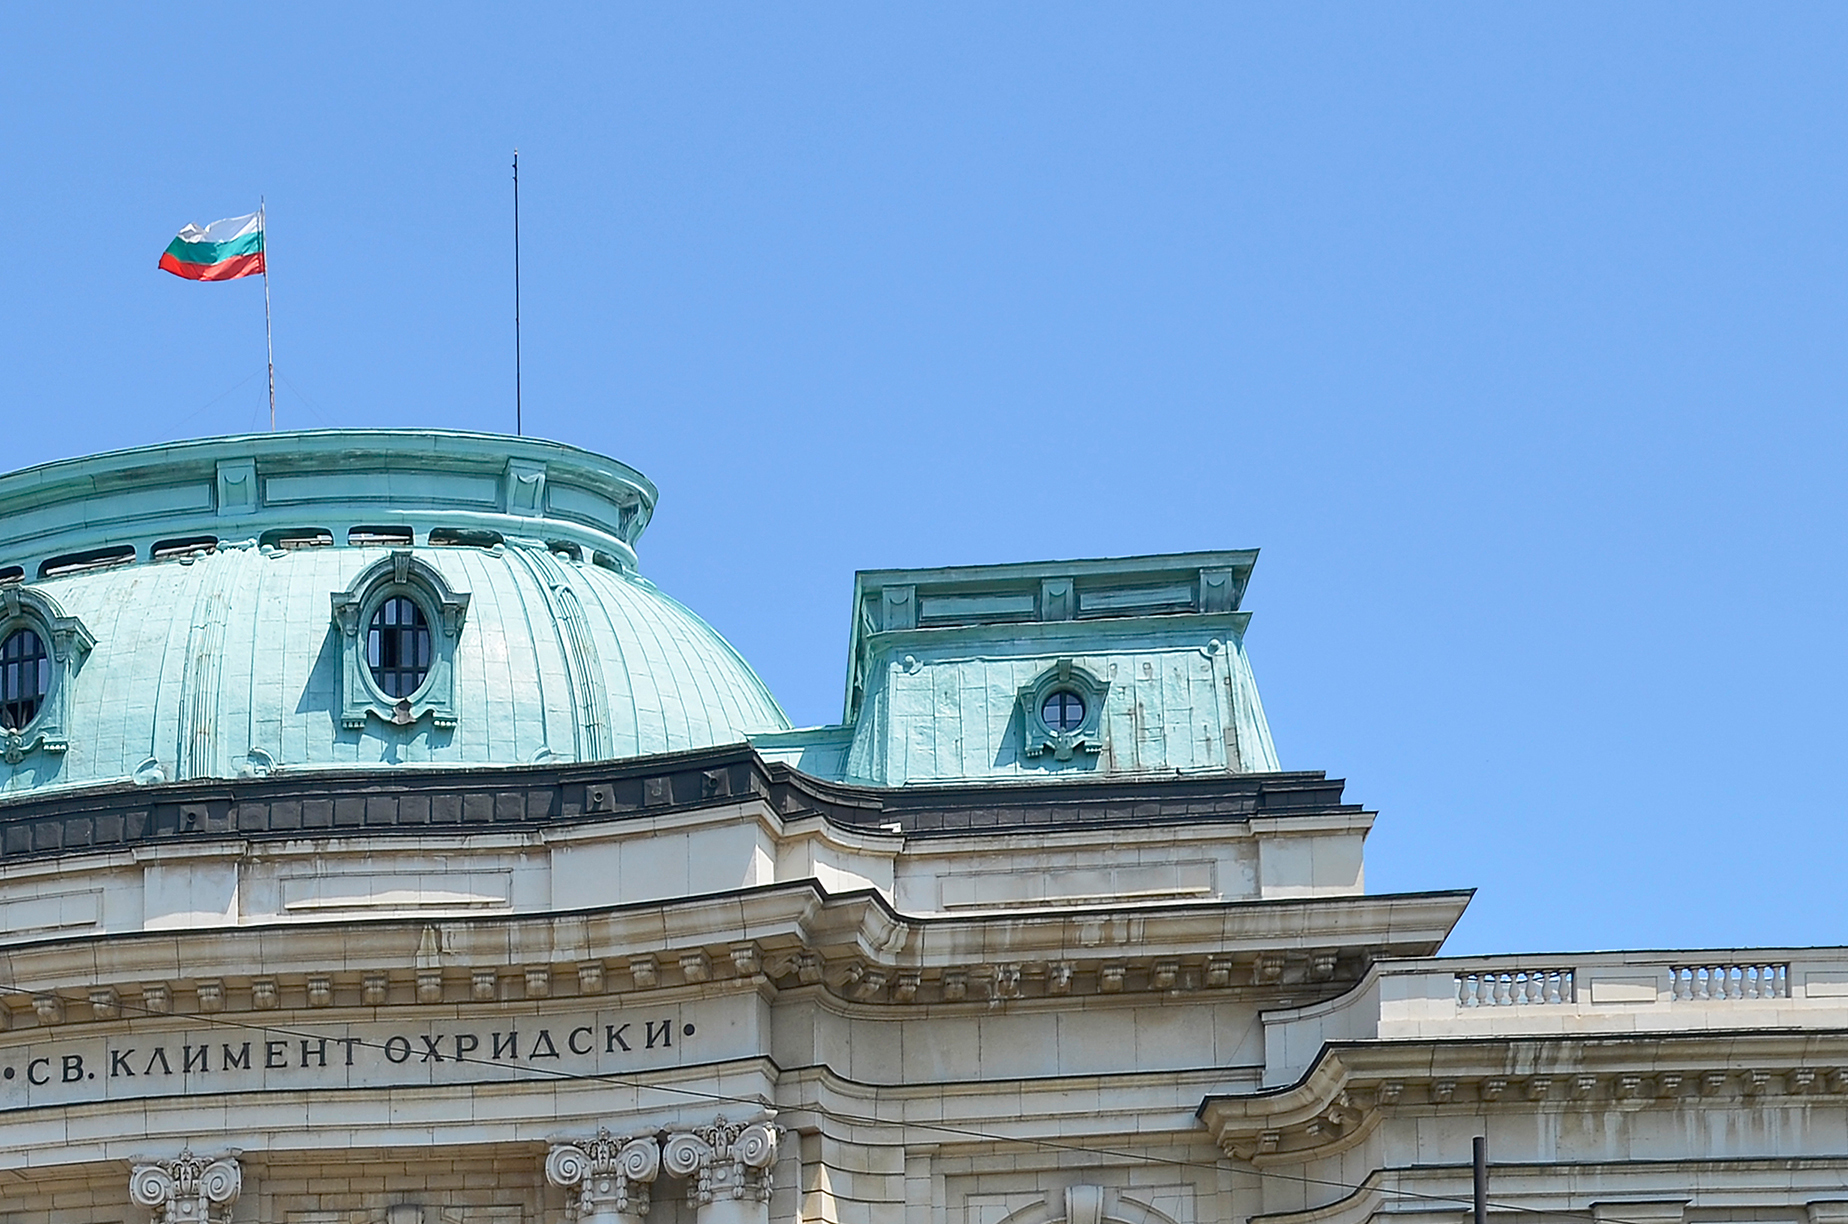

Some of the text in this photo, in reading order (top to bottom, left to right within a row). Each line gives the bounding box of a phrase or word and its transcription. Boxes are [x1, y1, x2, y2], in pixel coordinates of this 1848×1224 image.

[27, 1054, 95, 1085] СВ.
[110, 1037, 362, 1077] КЛИМЕНТ
[384, 1019, 673, 1064] ОХРИДСКИ
